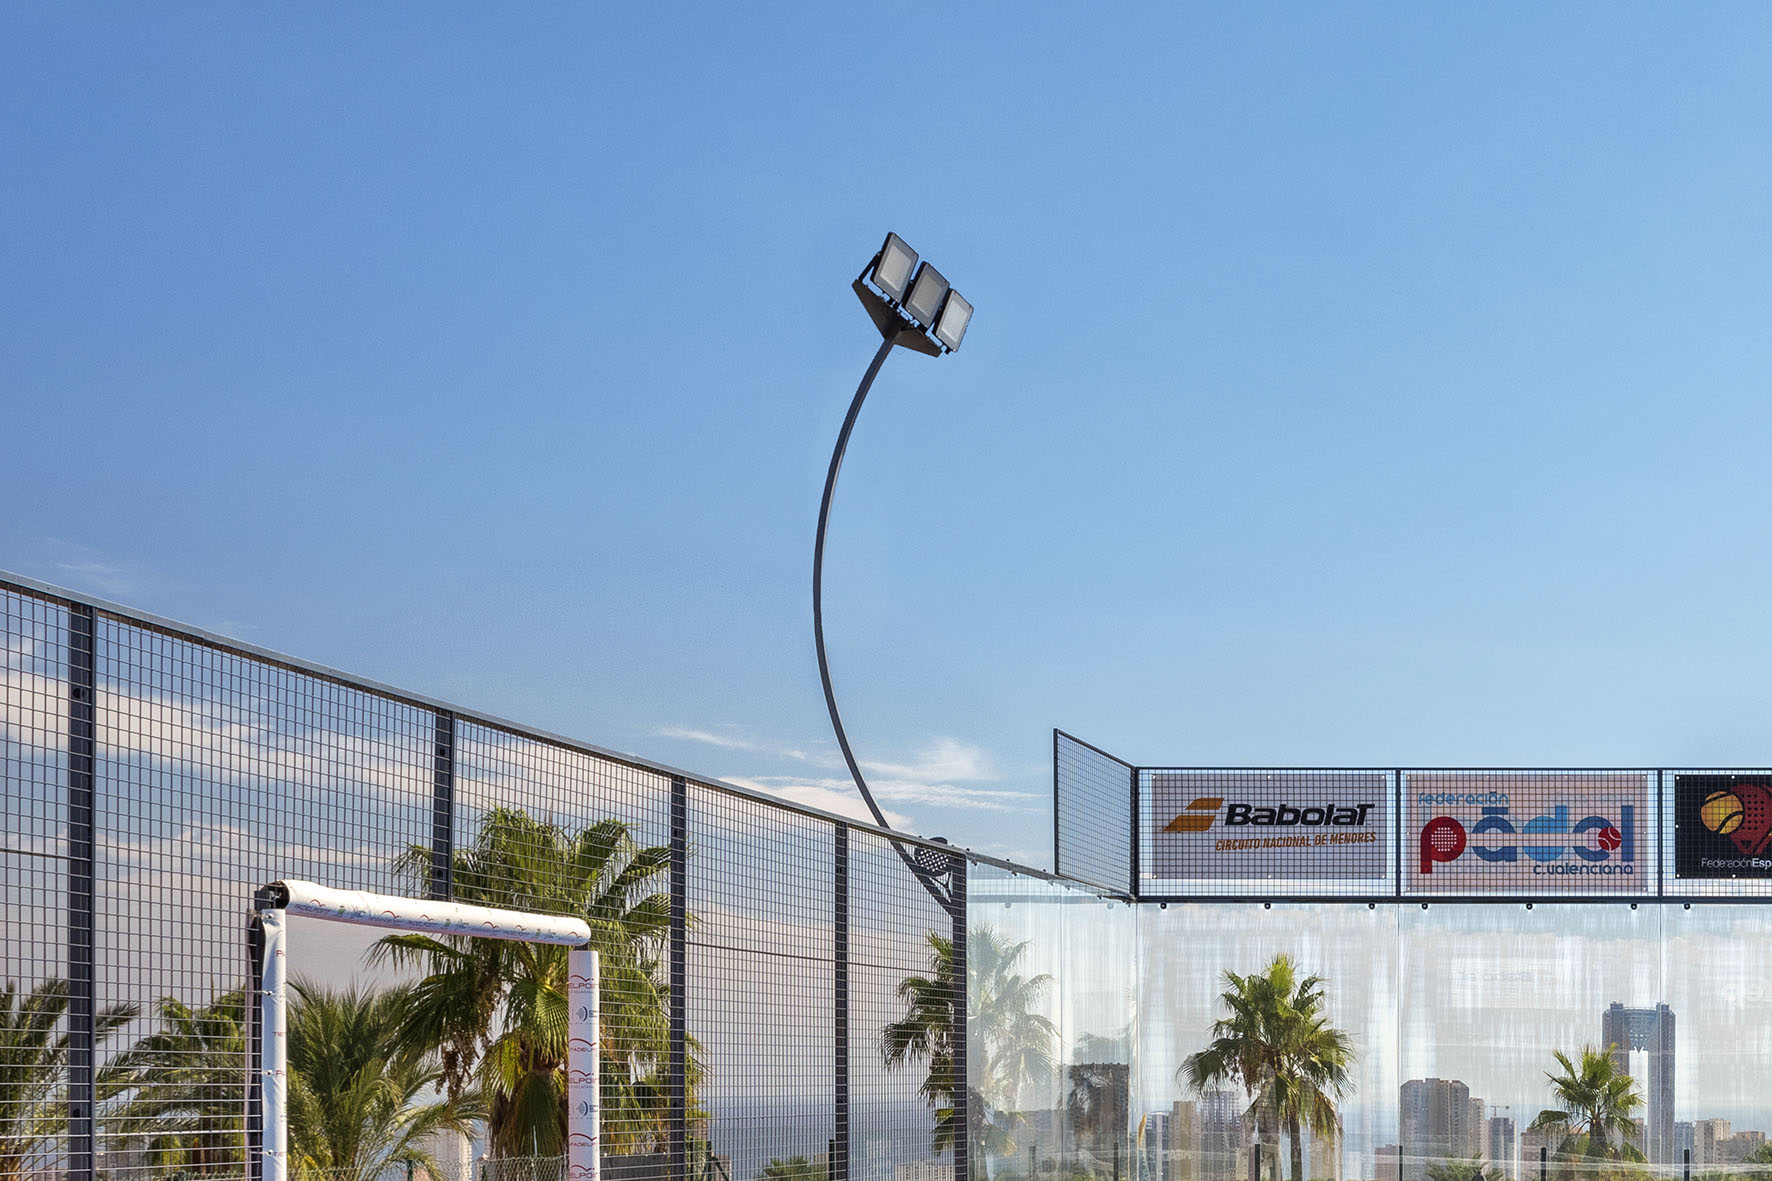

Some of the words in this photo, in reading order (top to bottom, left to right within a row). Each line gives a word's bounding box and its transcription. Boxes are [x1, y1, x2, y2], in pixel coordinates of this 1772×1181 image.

[1216, 838, 1261, 851] CIRCUITO
[1263, 835, 1312, 848] NACIONAL
[1315, 834, 1326, 846] DE
[1330, 832, 1376, 844] MENORES
